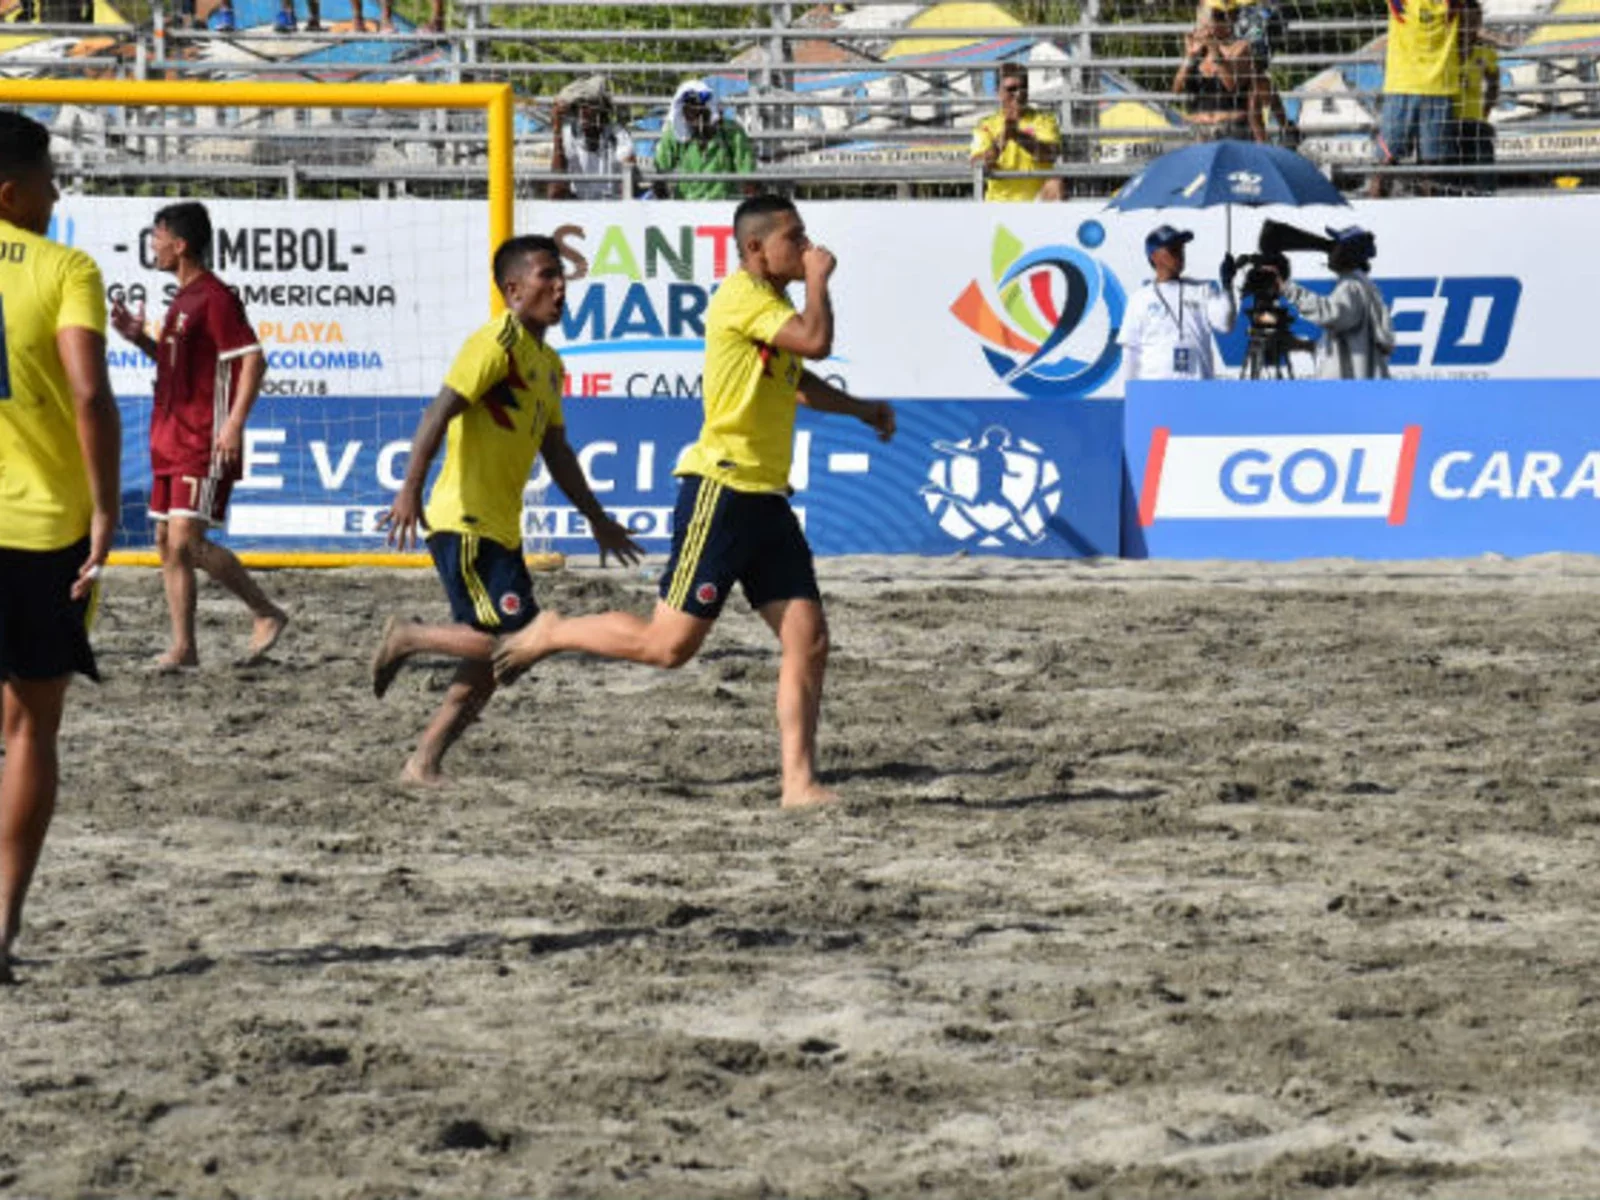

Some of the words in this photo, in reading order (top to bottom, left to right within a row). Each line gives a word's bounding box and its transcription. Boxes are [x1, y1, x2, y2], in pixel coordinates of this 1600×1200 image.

[553, 224, 735, 281] SANT
[258, 322, 344, 344] PLAYA
[267, 352, 383, 369] COLOMBIA
[182, 475, 197, 508] 7
[1219, 448, 1382, 506] GOL
